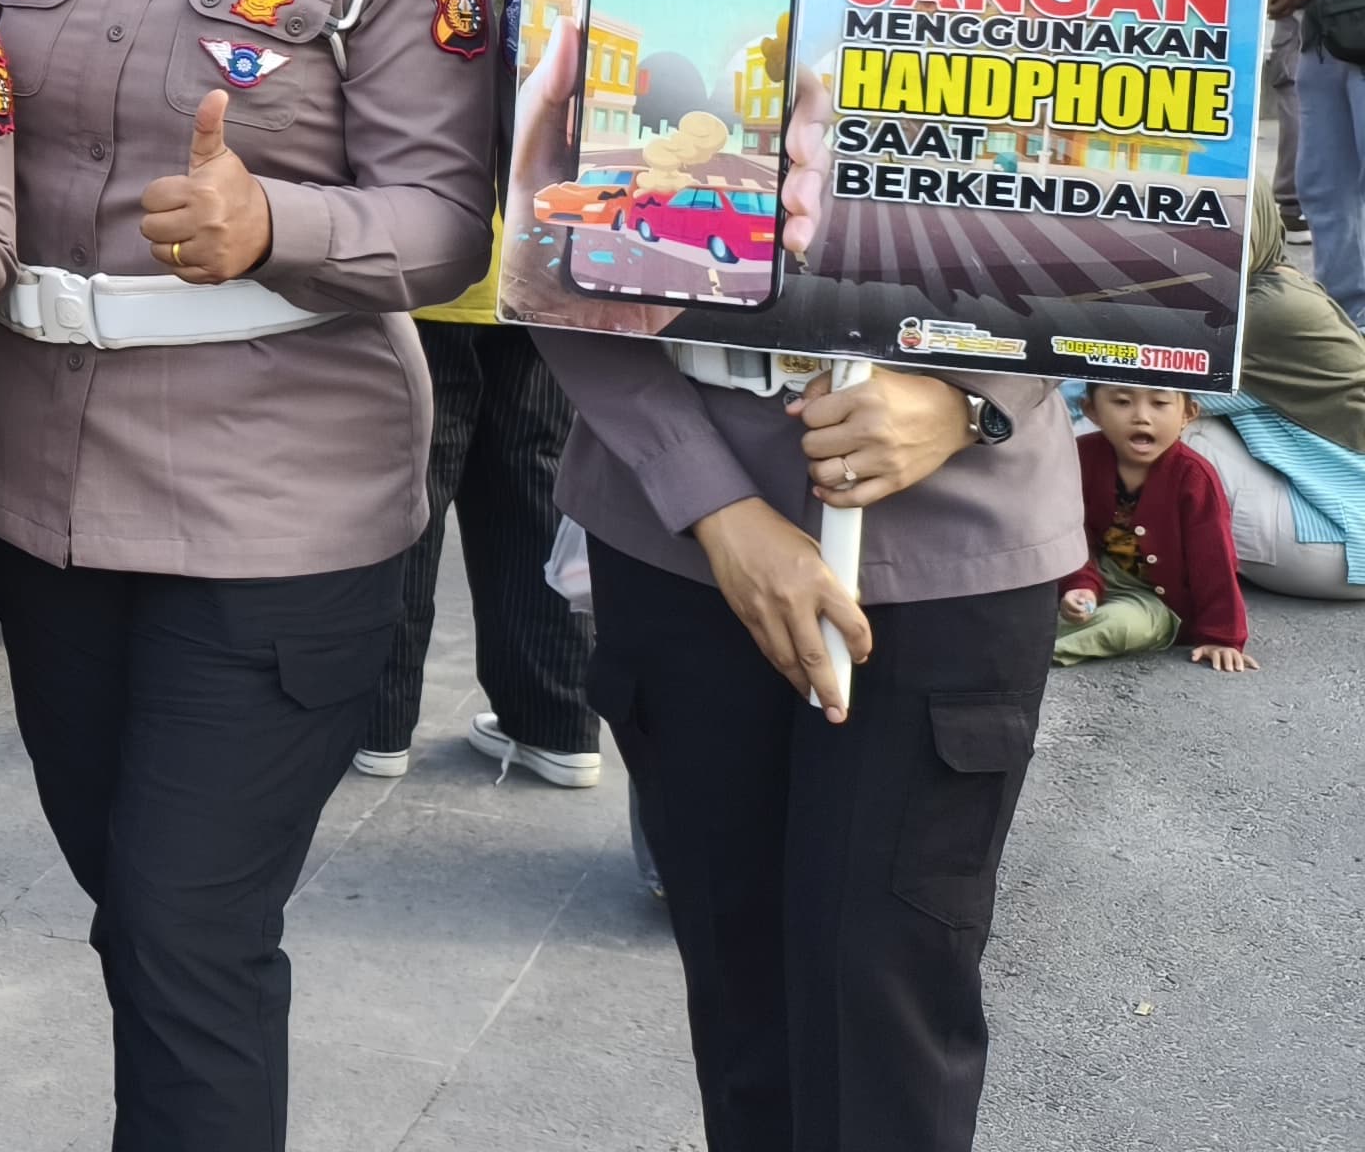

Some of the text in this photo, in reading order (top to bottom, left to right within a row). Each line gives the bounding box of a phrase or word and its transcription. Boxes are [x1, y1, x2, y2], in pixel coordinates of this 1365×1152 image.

[845, 11, 1228, 59] MENGGUNAKAN
[840, 49, 1230, 132] HANDPHONE
[836, 121, 986, 163] SAAT
[834, 162, 1230, 226] BERKENDARA
[1054, 338, 1207, 372] TOGETHER STRONG
[1089, 354, 1137, 366] WE ARE
